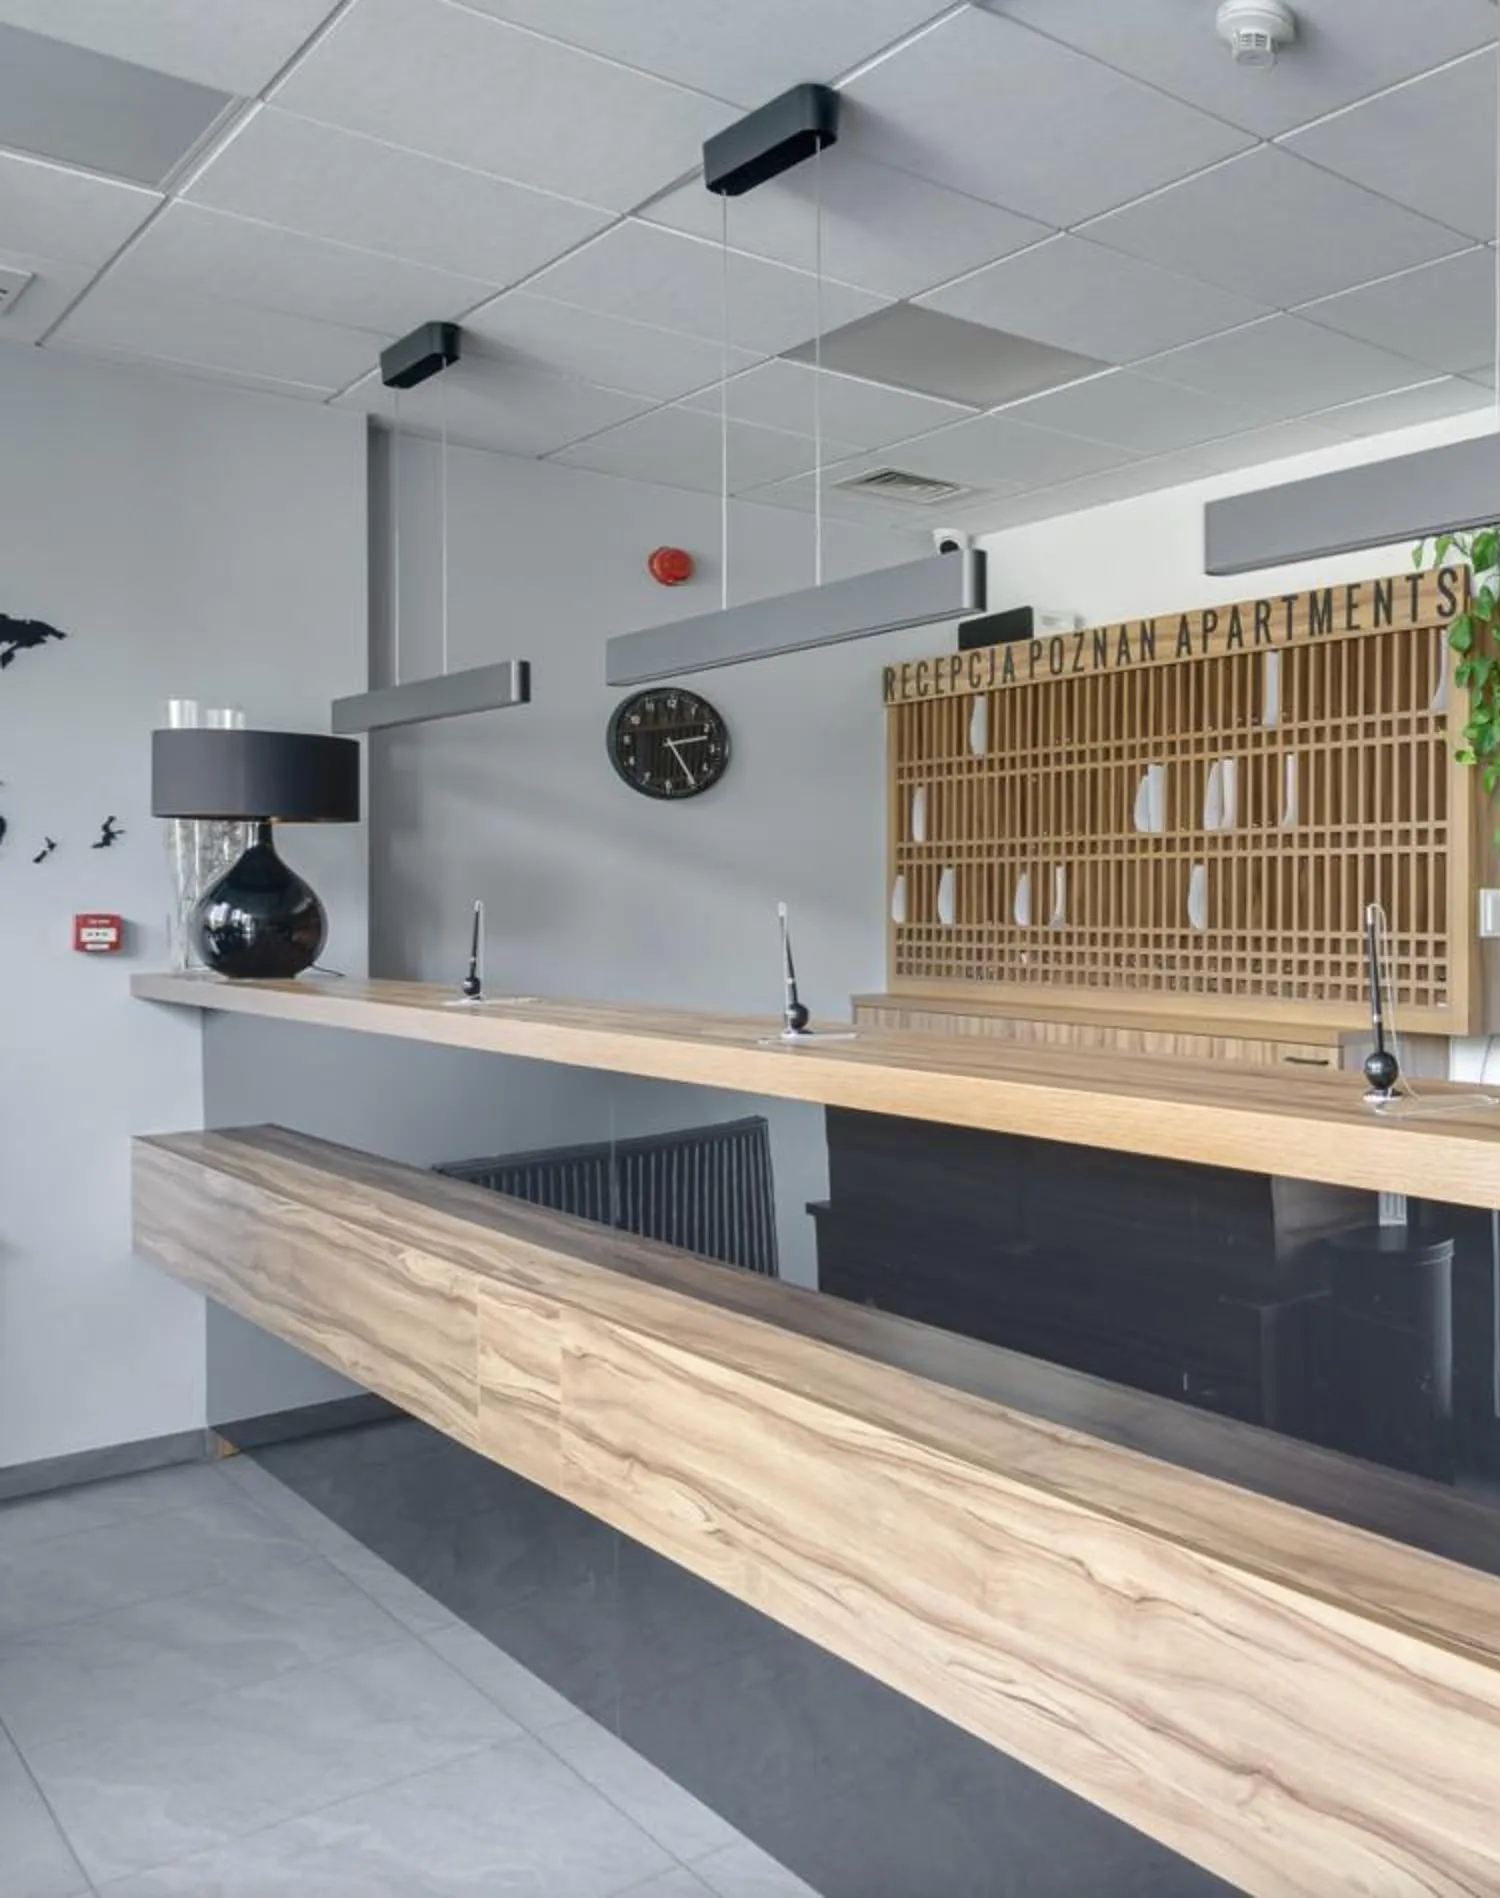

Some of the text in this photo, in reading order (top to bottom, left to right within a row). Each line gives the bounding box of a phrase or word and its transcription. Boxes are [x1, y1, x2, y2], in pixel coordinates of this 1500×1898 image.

[883, 567, 1458, 701] RECEPCJA POZNAN APARTMENTS
